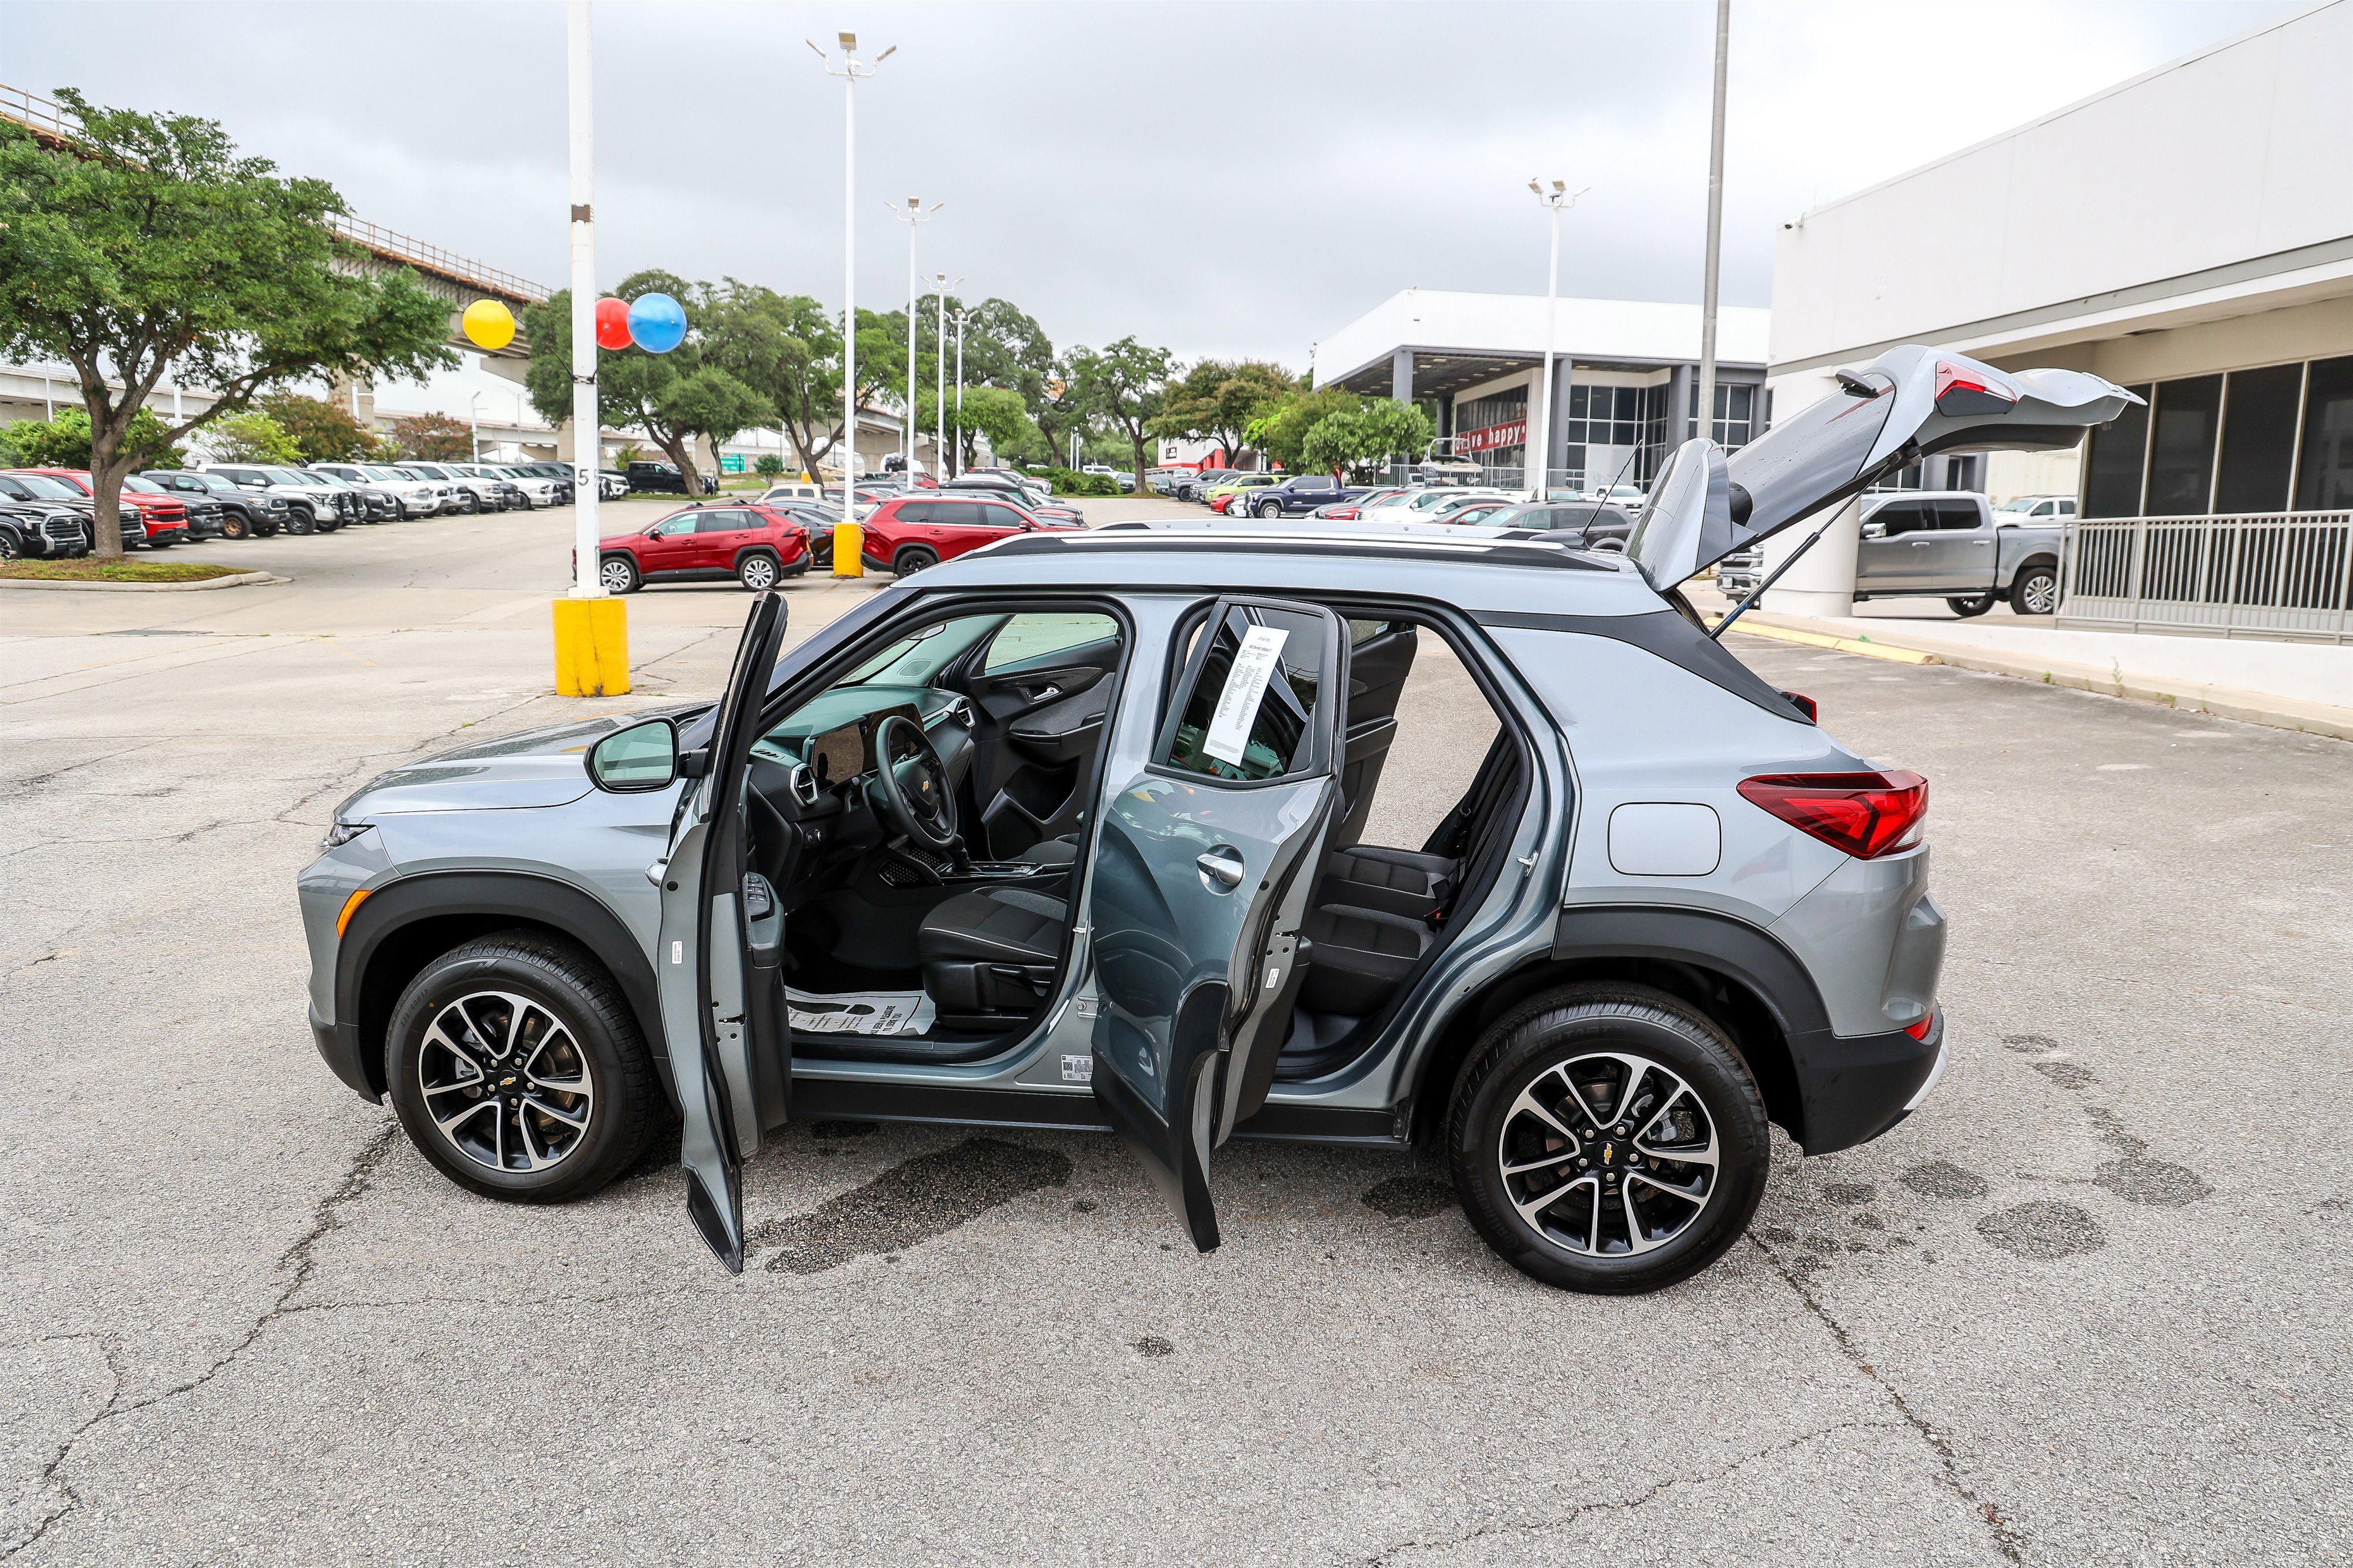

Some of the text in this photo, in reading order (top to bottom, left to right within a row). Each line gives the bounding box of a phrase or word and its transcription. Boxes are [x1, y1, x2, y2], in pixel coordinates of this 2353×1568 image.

[1456, 425, 1520, 450] drive happy
[577, 468, 589, 486] 5
